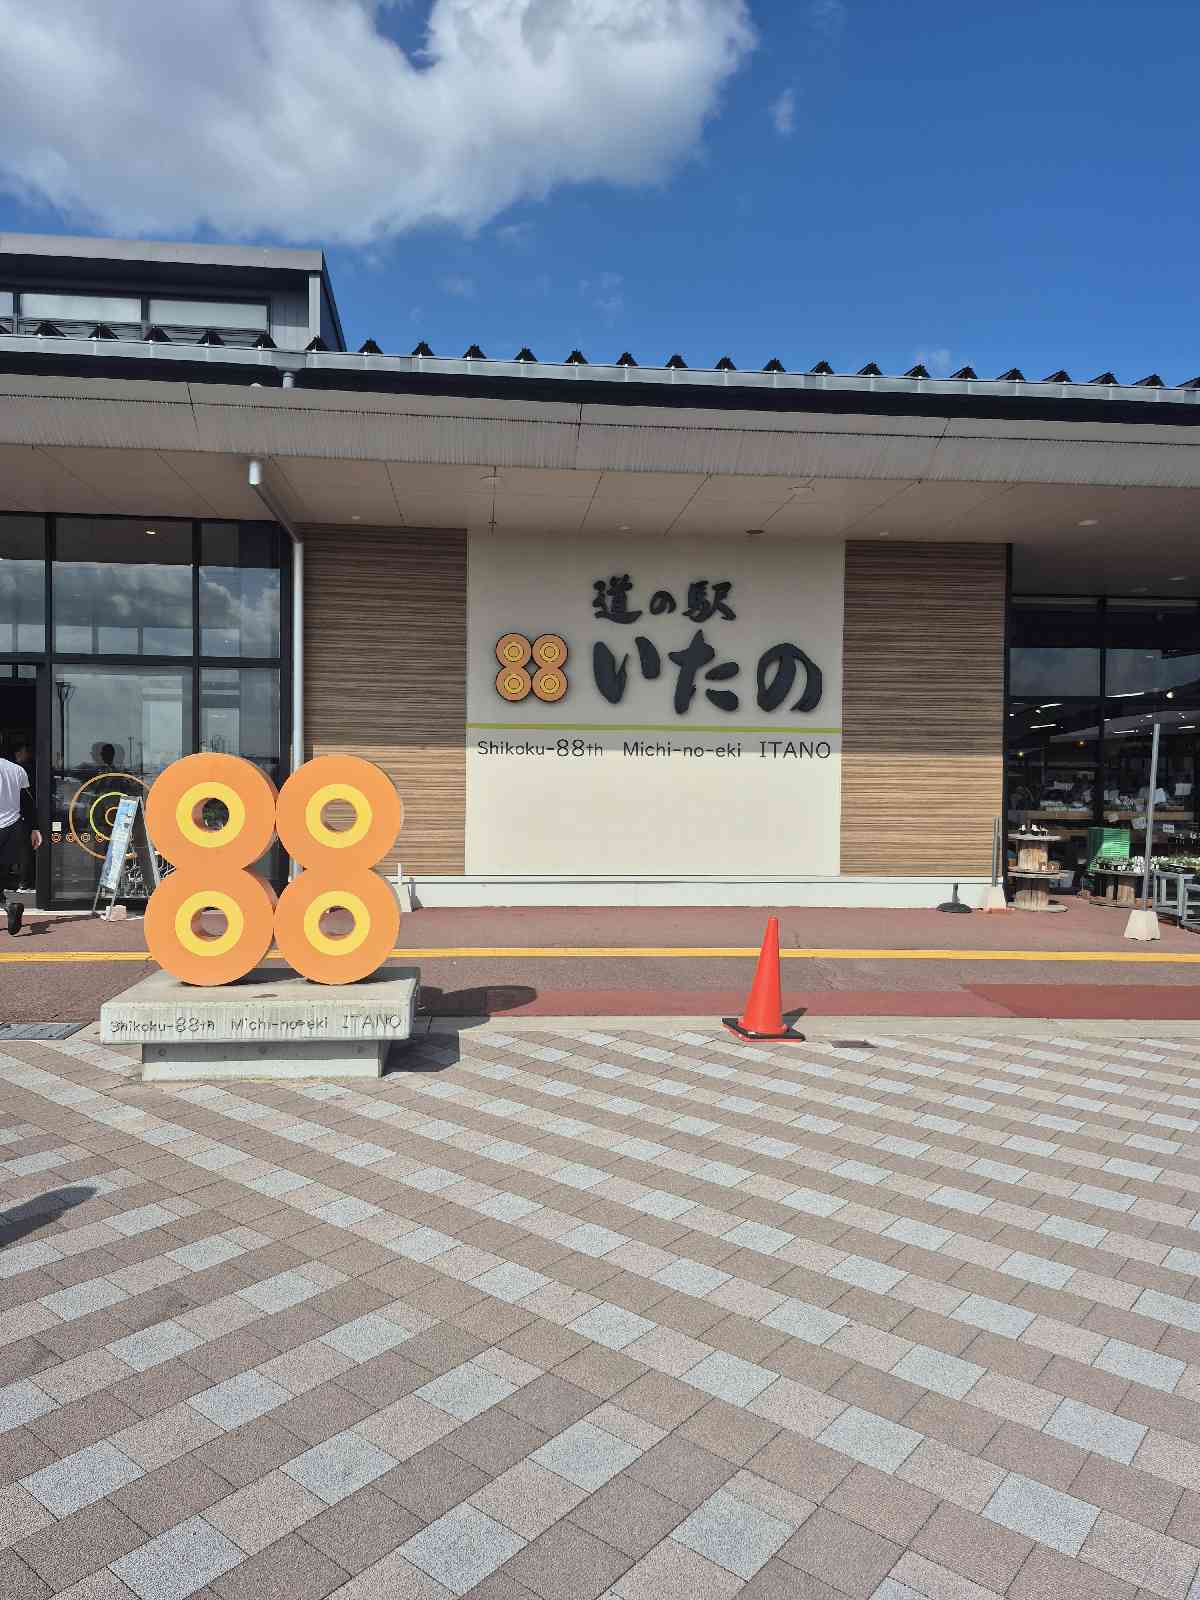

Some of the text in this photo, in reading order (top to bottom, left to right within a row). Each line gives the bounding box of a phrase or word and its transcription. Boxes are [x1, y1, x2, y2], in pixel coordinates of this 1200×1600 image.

[592, 574, 737, 624] 道の駅
[592, 629, 823, 715] いたの
[477, 738, 832, 759] Shikoku-88th Michi-no-eki ITANO
[342, 1013, 403, 1030] ITANO
